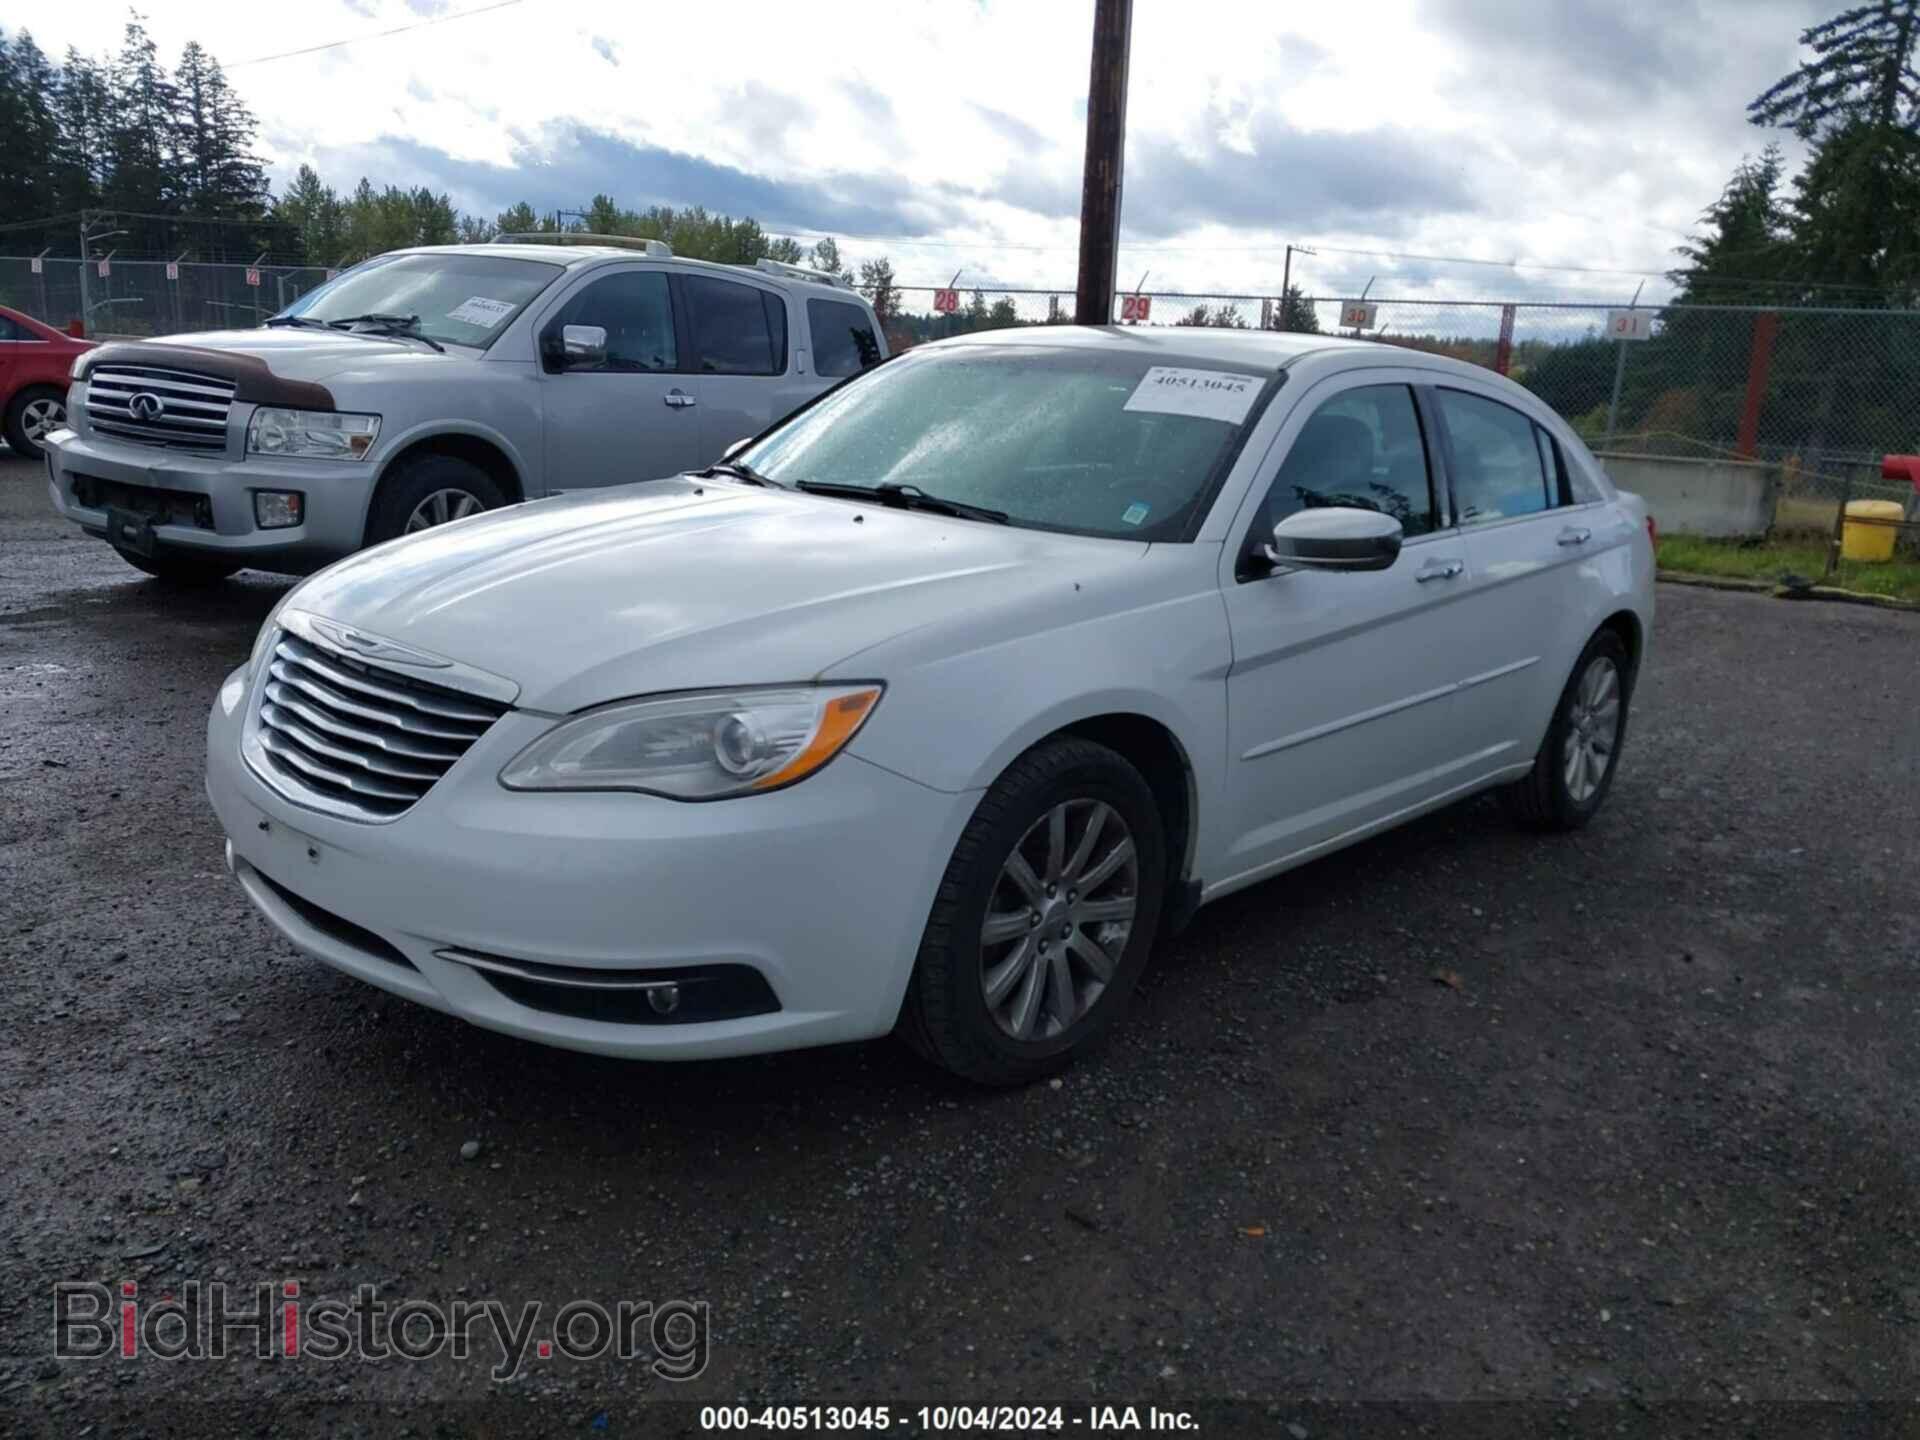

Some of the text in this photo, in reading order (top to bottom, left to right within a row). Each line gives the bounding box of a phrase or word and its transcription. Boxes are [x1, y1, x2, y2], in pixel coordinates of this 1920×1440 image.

[936, 290, 959, 311] 28
[1123, 296, 1150, 320] 29
[1348, 308, 1366, 322] 30
[1616, 317, 1637, 333] 31
[1152, 376, 1246, 392] 40513045
